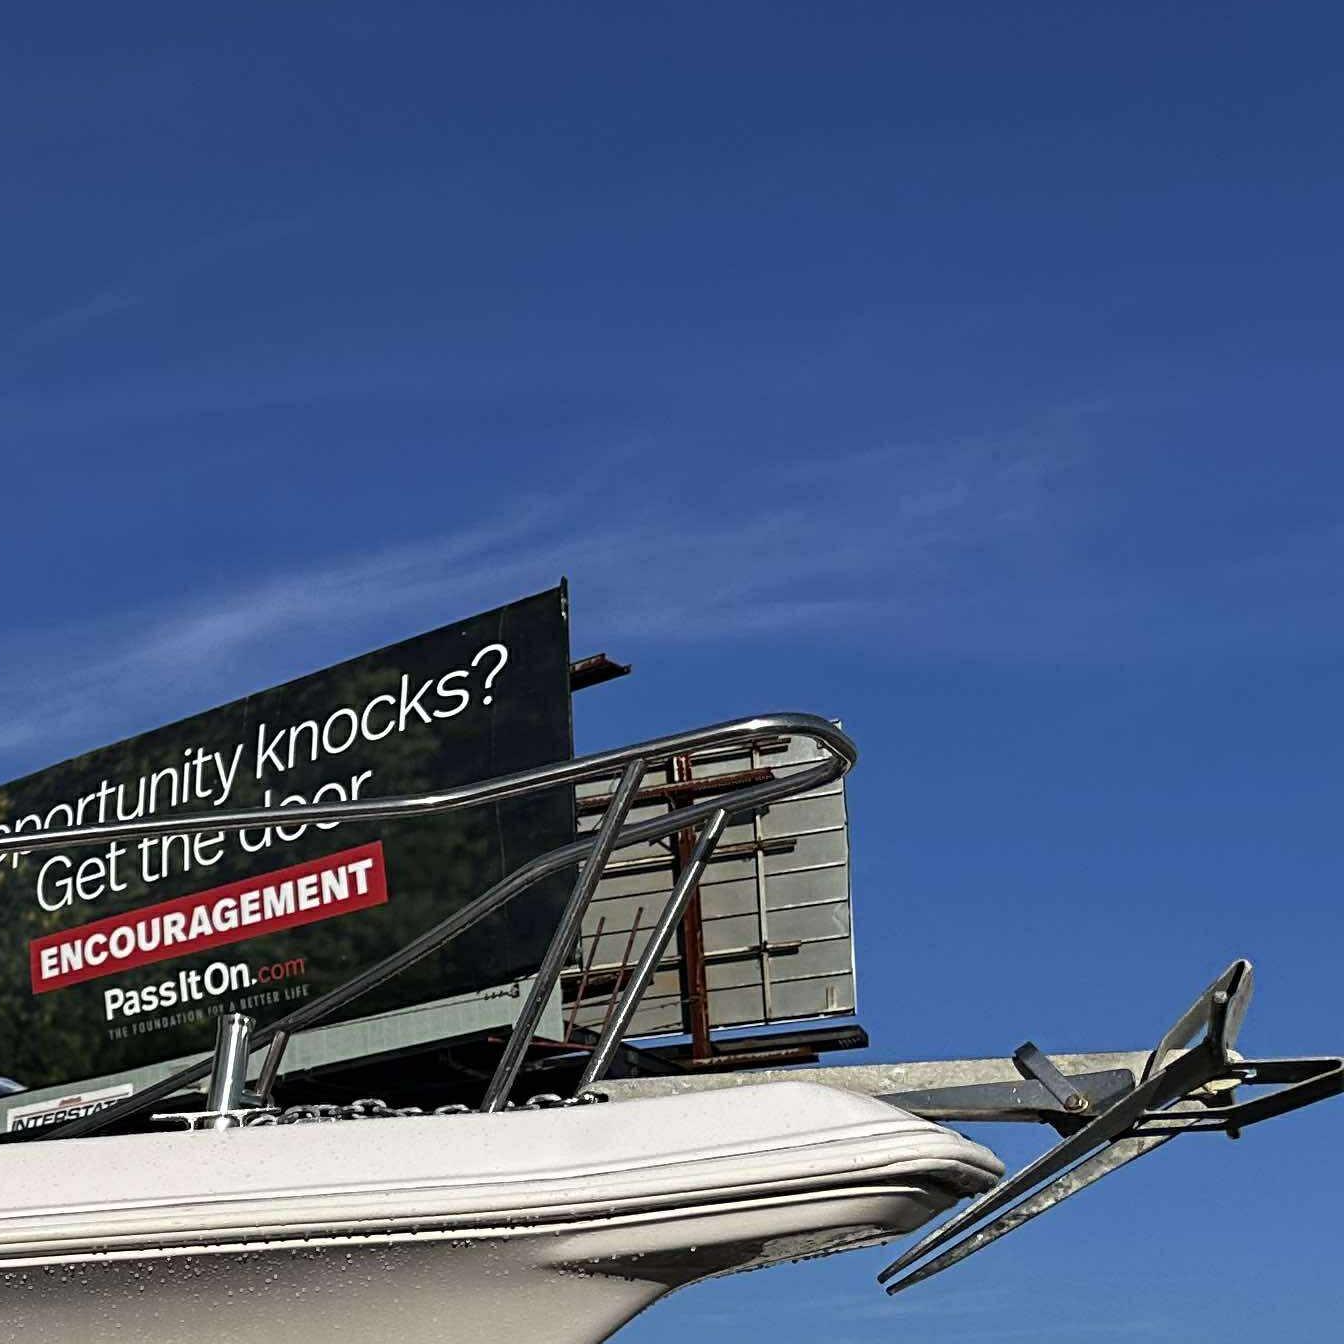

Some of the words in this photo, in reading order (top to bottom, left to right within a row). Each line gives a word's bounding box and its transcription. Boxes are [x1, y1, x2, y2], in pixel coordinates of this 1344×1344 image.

[256, 643, 509, 779] knocks?
[36, 841, 127, 912] Get
[137, 826, 225, 883] the
[239, 769, 373, 852] door
[40, 858, 374, 980] ENCOURAGEMENT
[104, 957, 306, 1021] PassItOn.com
[132, 1009, 205, 1036] FOUNDATION
[241, 990, 281, 1010] BETTER
[284, 984, 310, 1001] LIFE
